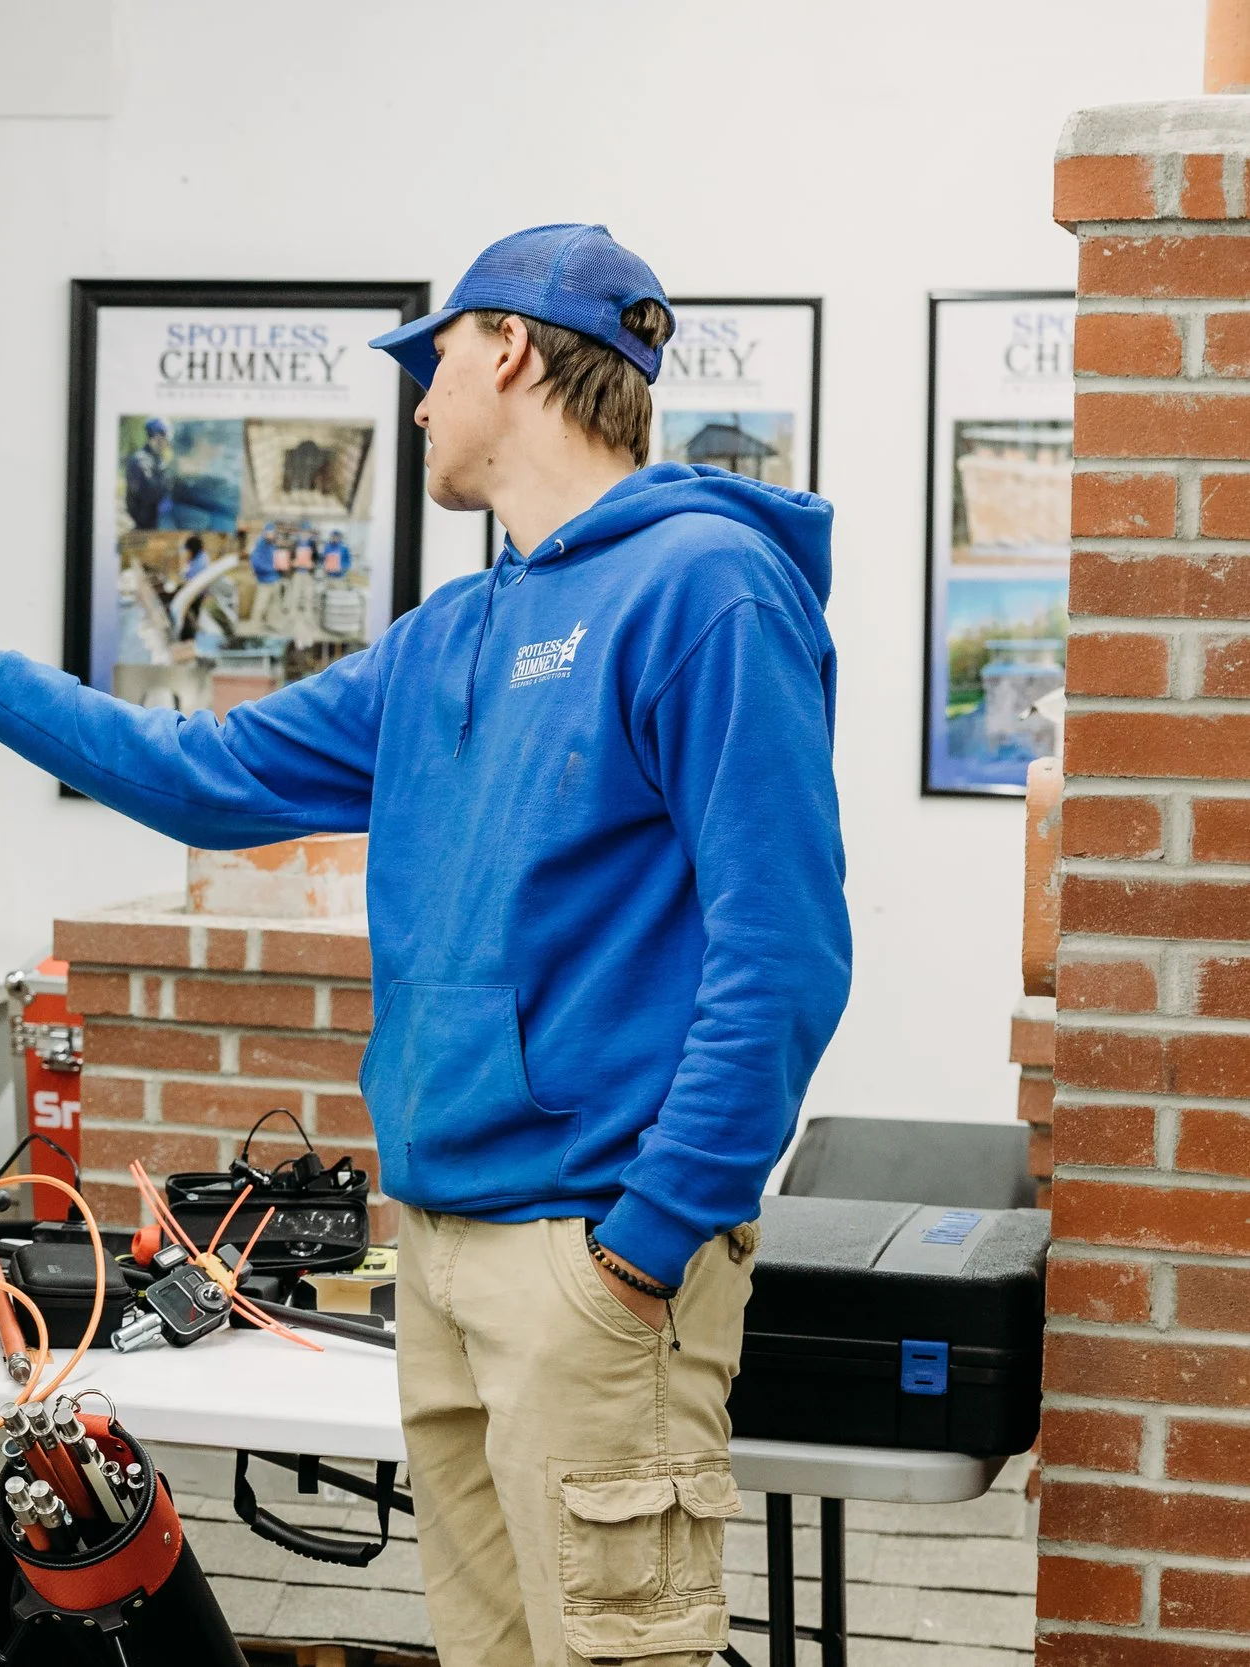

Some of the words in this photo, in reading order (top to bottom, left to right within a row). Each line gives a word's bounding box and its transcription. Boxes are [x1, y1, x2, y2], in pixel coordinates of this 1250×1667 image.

[166, 323, 329, 349] SPOTLESS
[159, 345, 347, 382] CHIMNEY
[517, 639, 563, 660] SPOTLESS
[512, 652, 562, 678] CHIMNEY
